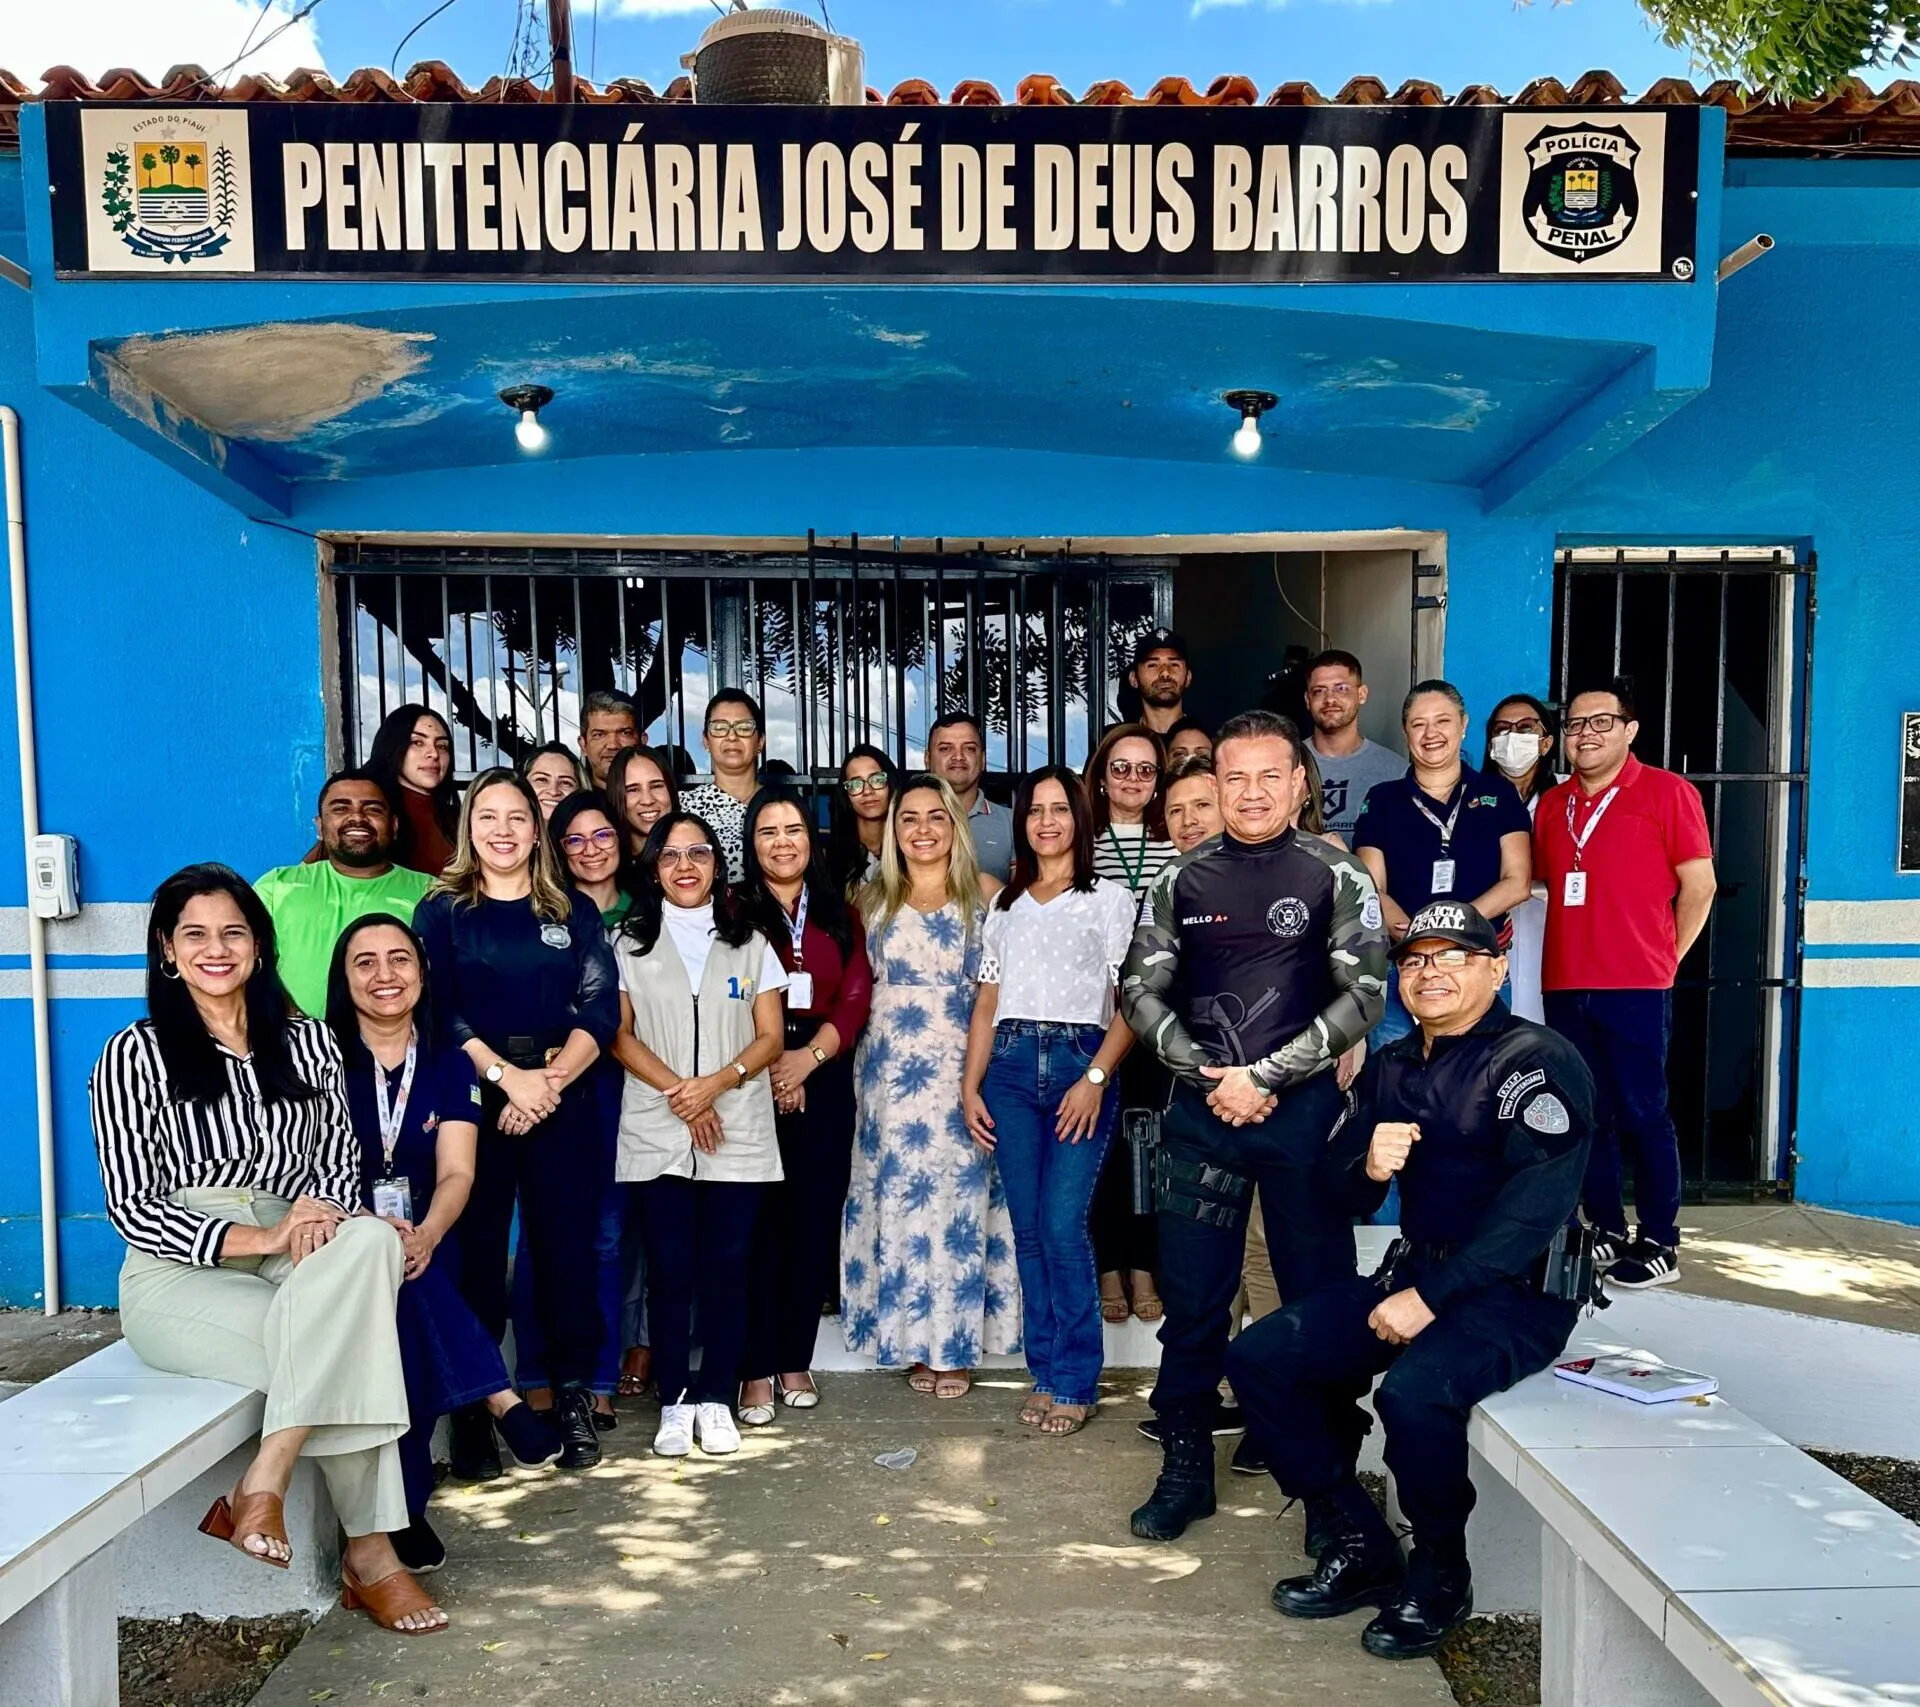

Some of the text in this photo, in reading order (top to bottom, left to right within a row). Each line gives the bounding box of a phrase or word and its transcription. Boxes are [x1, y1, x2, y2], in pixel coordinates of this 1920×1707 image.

[133, 115, 164, 132] ESTADO
[1545, 134, 1619, 153] POLÍCIA
[283, 122, 1468, 255] PENITENCIÁRIA JOSÉ DE DEUS BARROS
[1547, 228, 1616, 246] PENAL
[1574, 250, 1586, 259] PI
[1182, 915, 1213, 926] MELLO
[1406, 915, 1466, 938] PENAL
